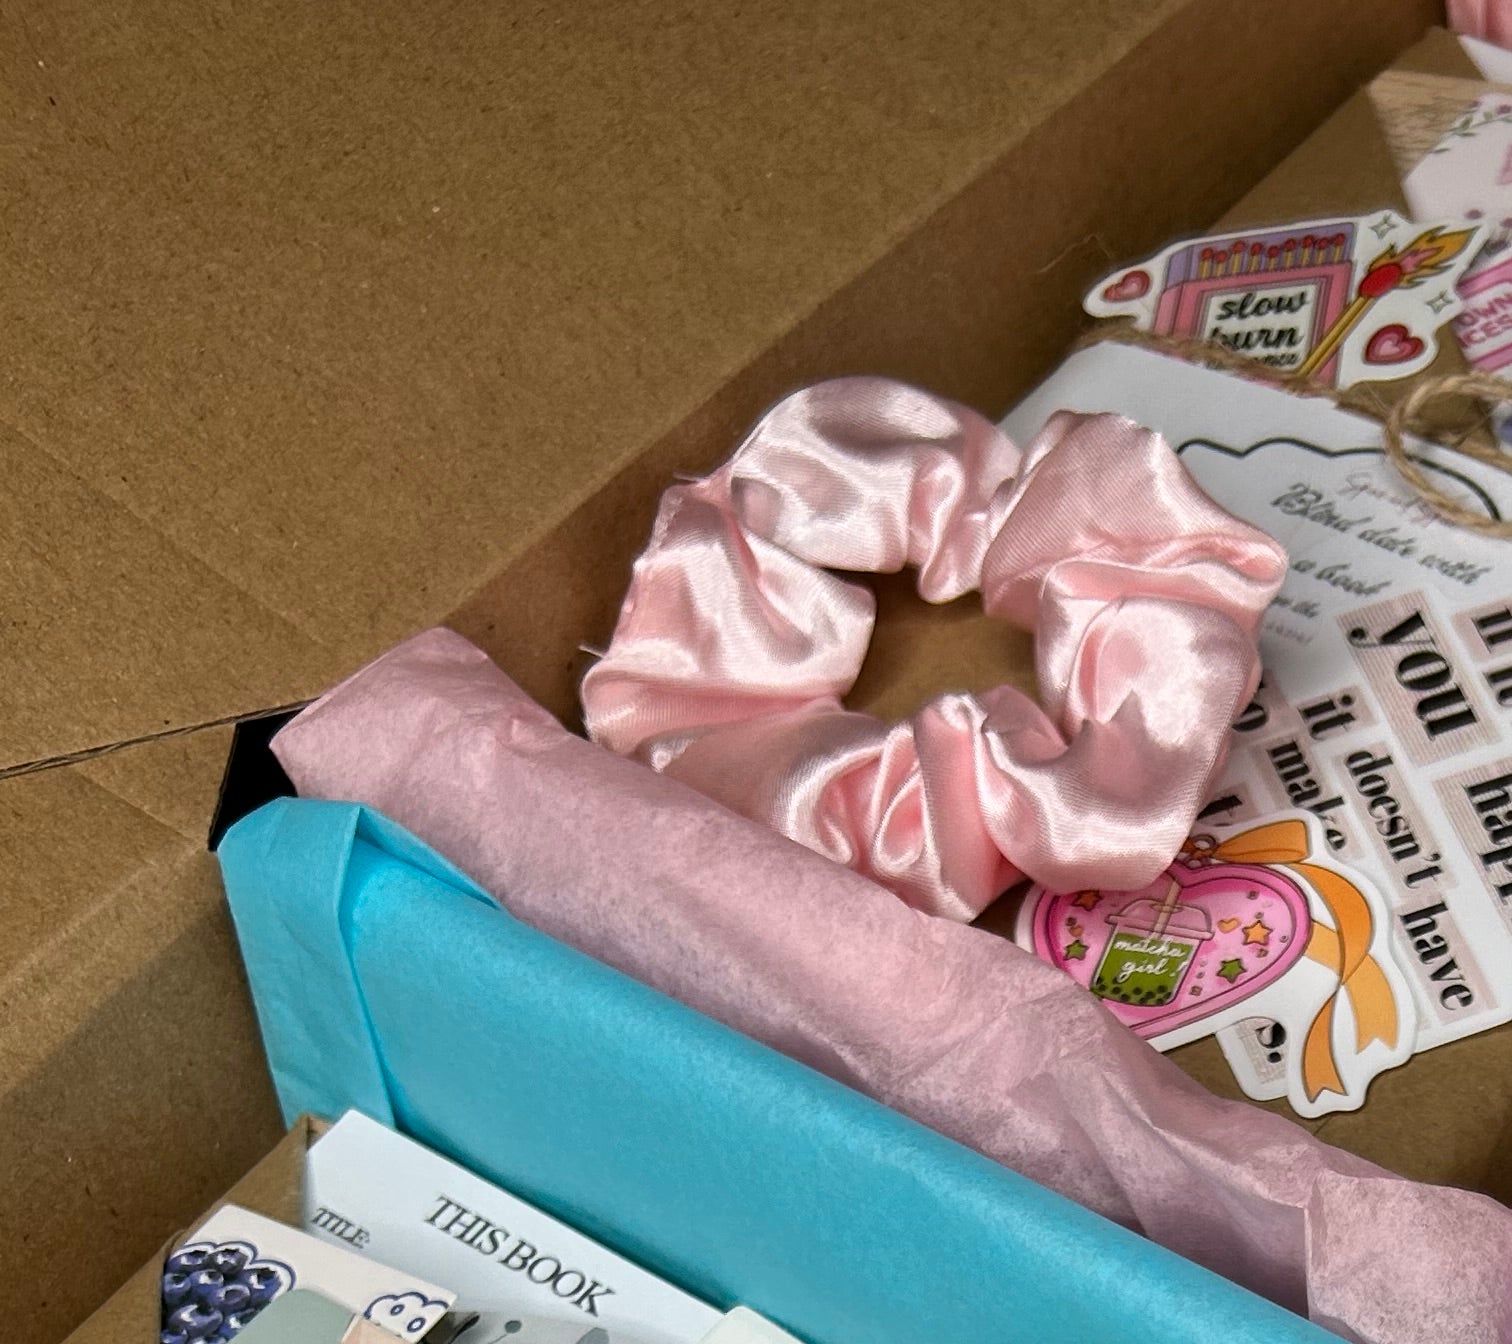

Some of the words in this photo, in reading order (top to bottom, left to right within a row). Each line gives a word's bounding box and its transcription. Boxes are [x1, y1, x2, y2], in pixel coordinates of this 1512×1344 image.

[1216, 291, 1307, 320] slow
[1347, 610, 1479, 743] you
[1299, 694, 1356, 741] it
[1346, 749, 1447, 890] doesn't
[1400, 901, 1475, 1012] have
[1113, 936, 1187, 958] matcha
[425, 1195, 509, 1255] THIS
[496, 1238, 617, 1318] BOOK
